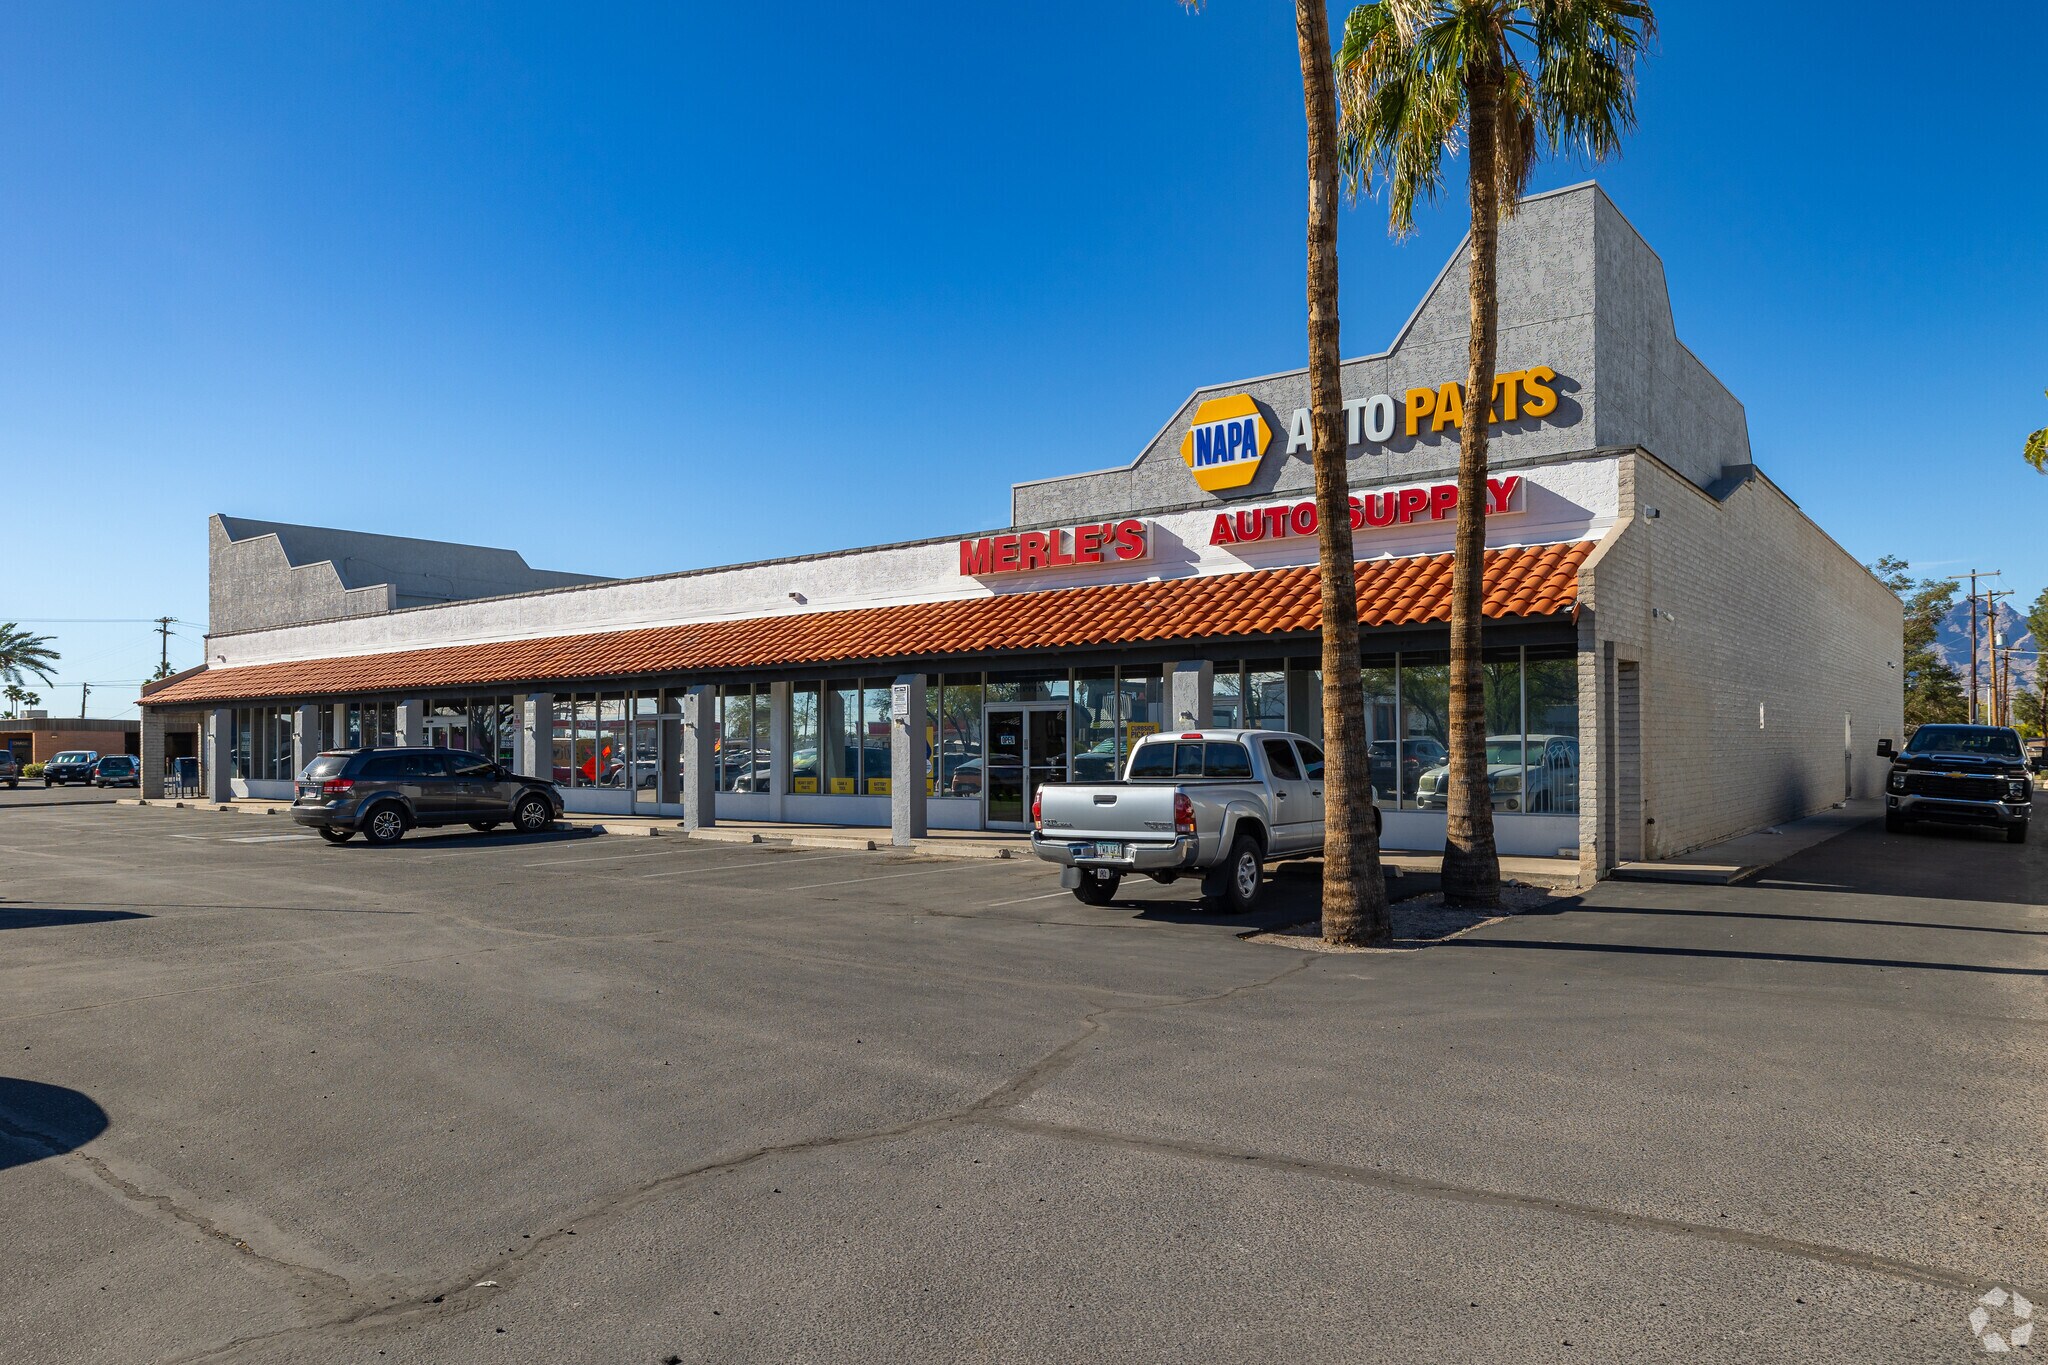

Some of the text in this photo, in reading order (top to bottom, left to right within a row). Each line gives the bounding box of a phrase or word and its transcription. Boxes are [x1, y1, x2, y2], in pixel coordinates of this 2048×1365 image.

[1196, 418, 1258, 467] NAPA
[1286, 394, 1396, 454] ATO
[959, 475, 1520, 576] MERLE'S AUTO SUPPY
[1002, 736, 1014, 744] OPEN
